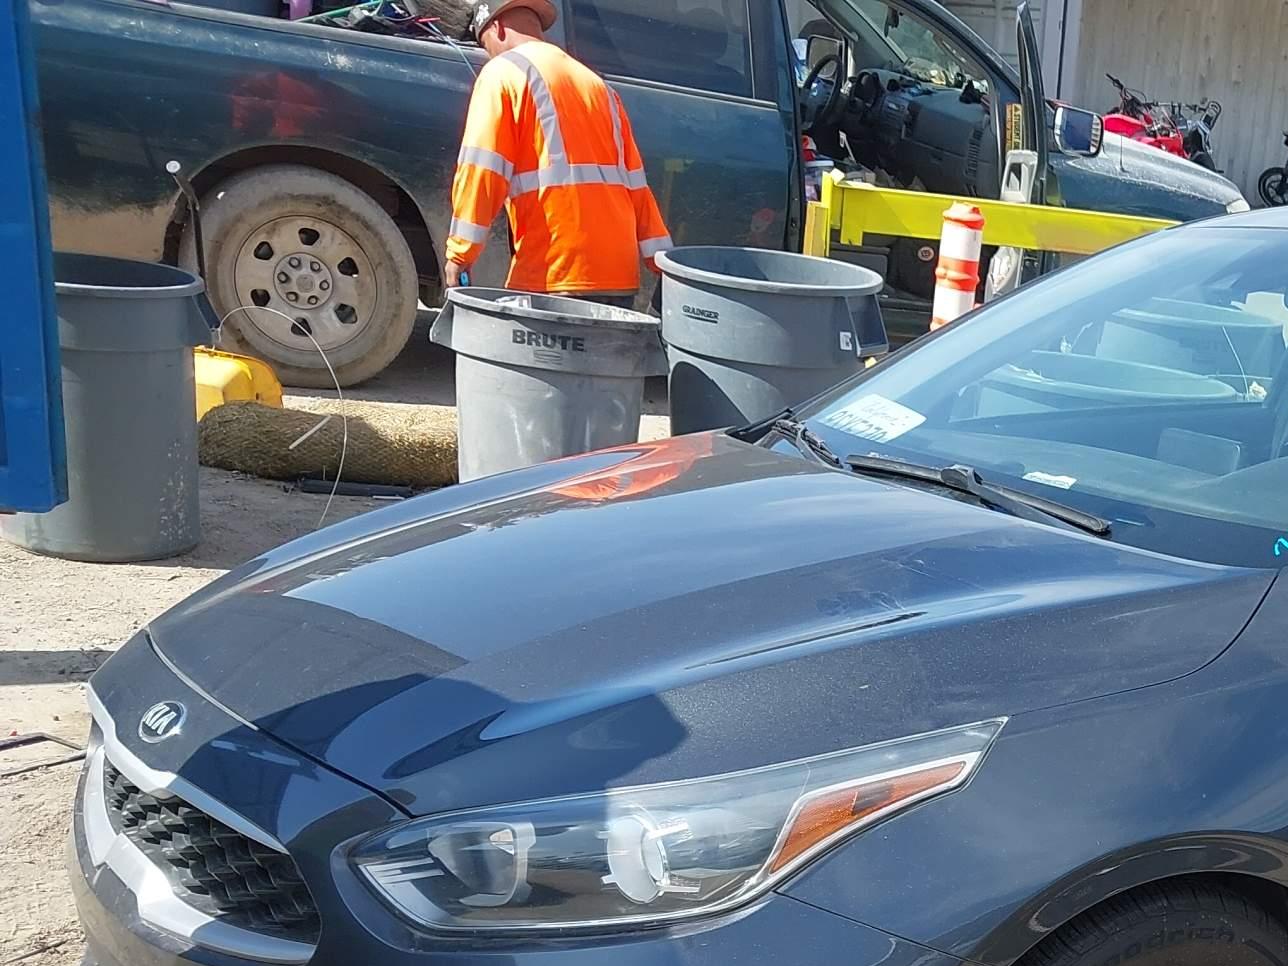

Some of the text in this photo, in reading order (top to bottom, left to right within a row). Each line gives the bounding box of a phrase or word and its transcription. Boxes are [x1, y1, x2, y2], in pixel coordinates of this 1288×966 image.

[682, 304, 719, 320] GRAINGER
[511, 328, 585, 352] BRUTE
[142, 702, 179, 737] KIA
